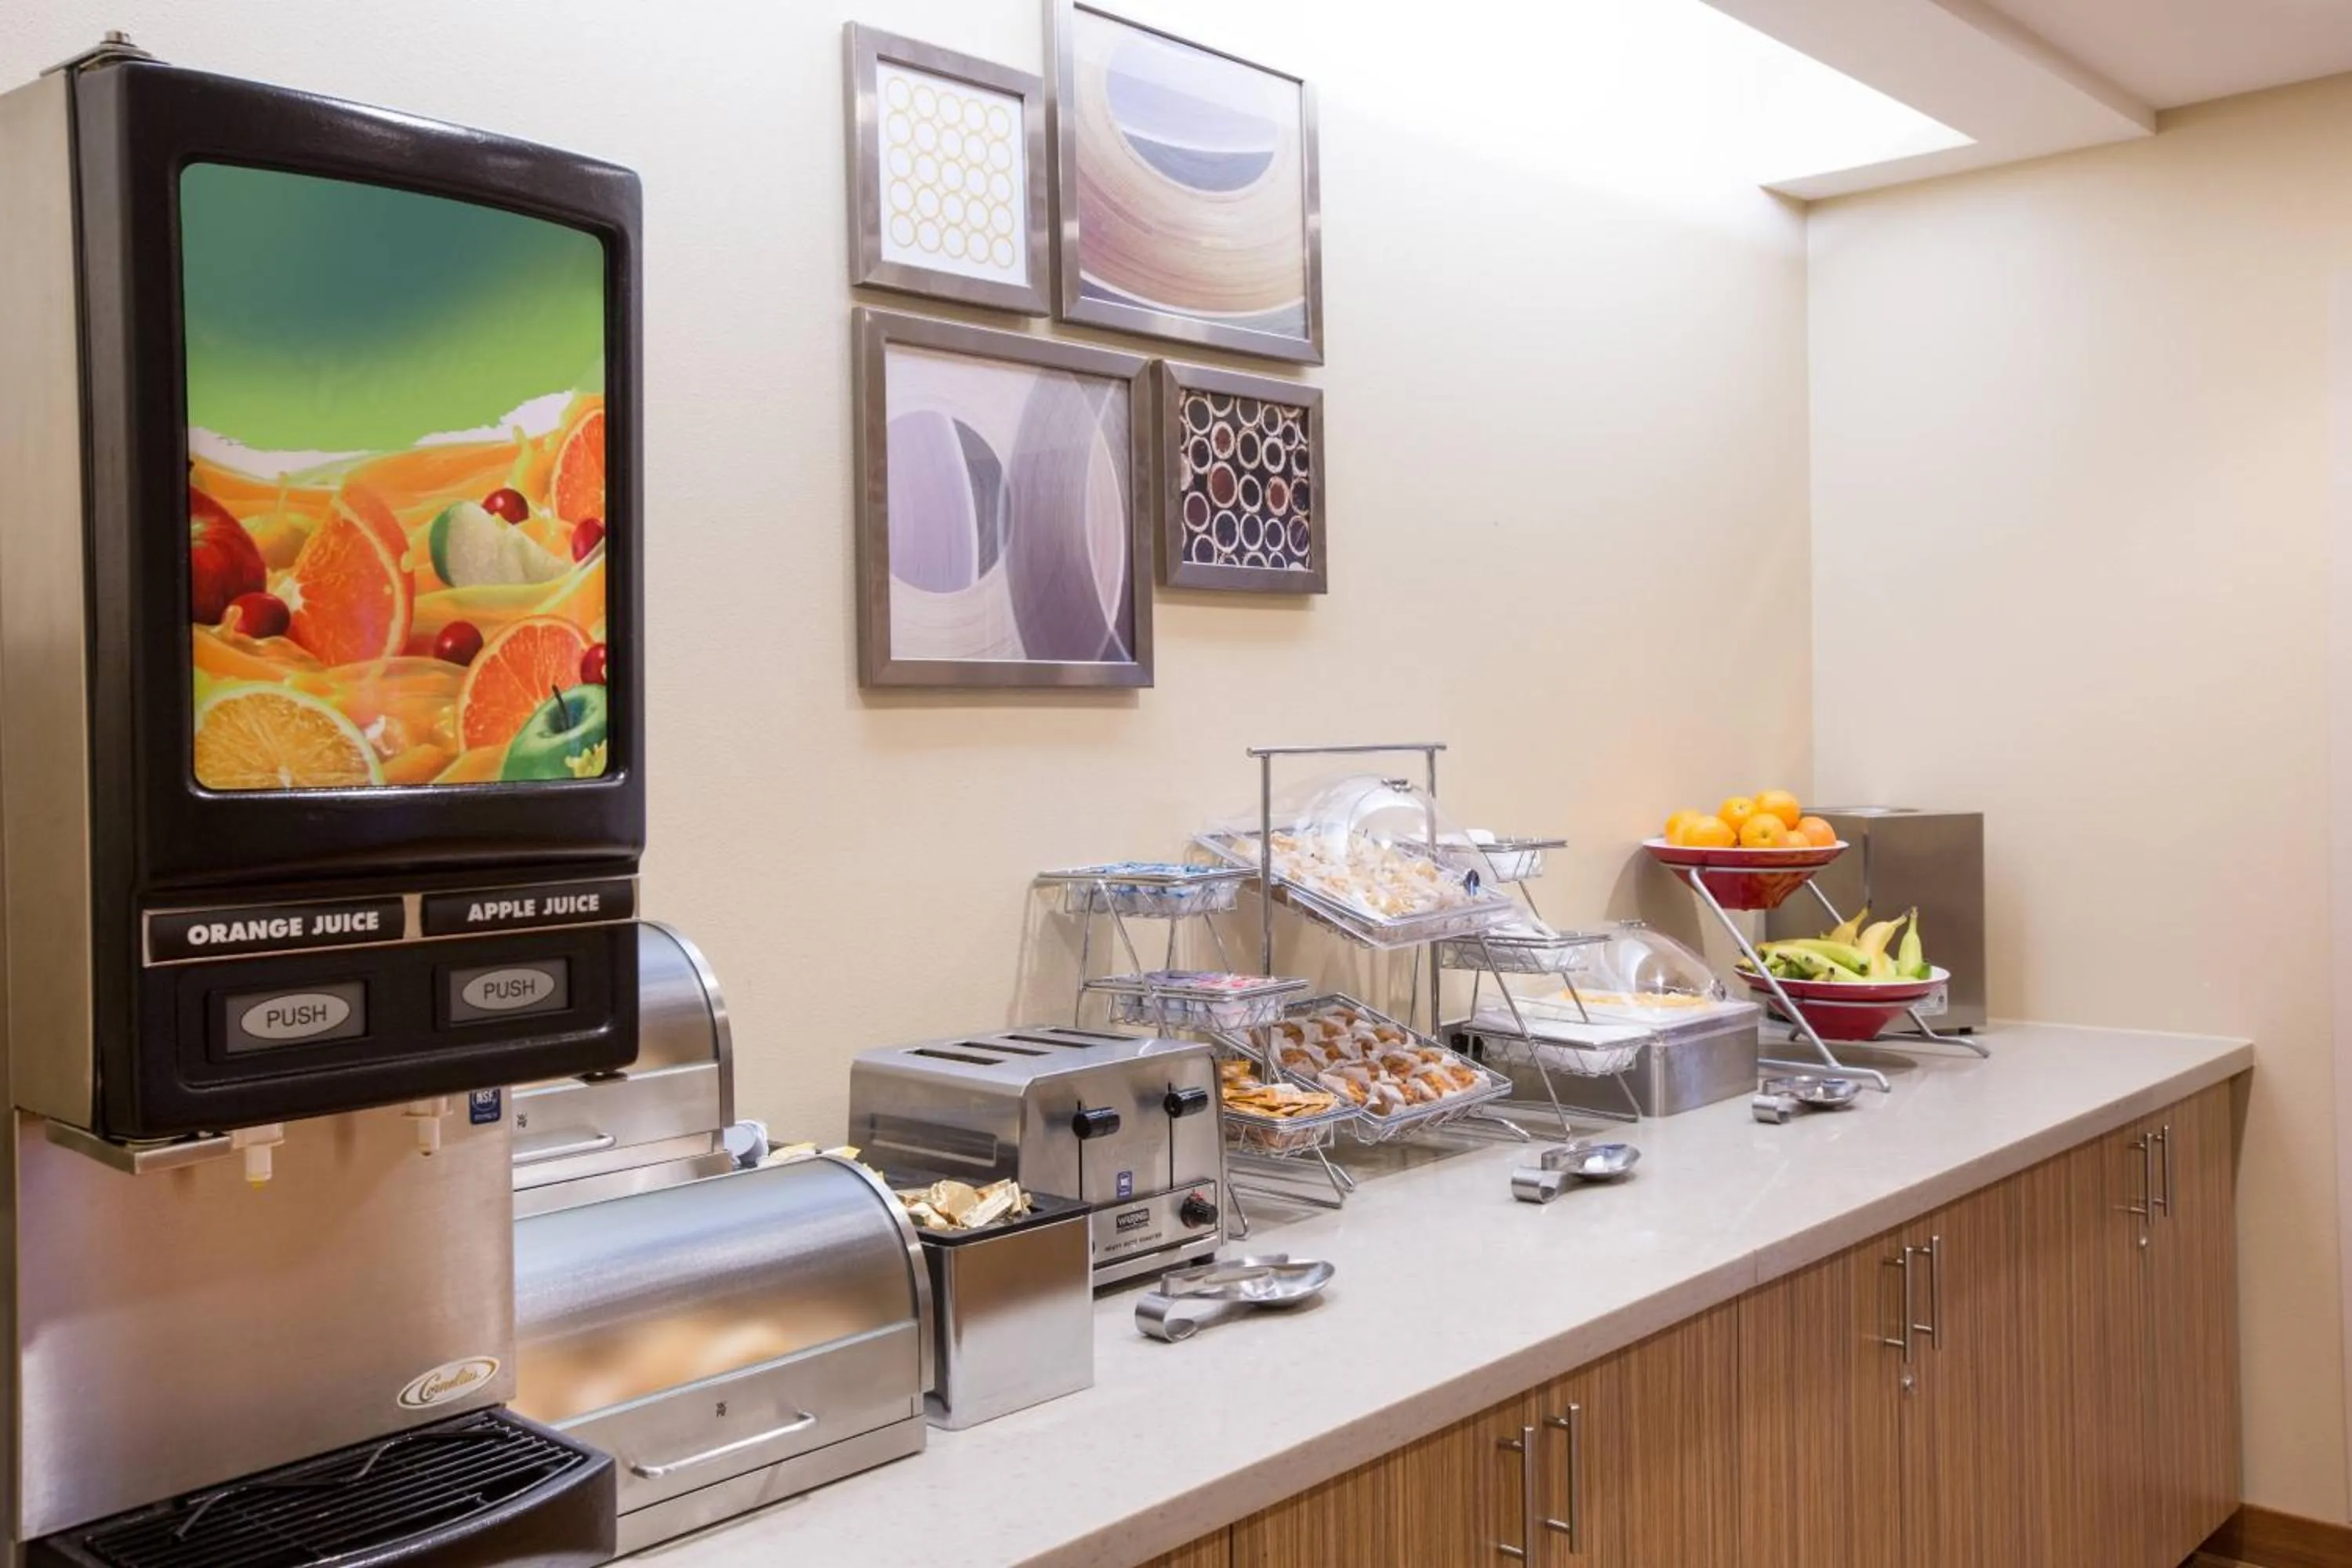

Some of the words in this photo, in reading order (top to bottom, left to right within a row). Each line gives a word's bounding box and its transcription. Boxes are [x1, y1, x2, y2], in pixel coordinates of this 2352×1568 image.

[466, 898, 536, 922] APPLE
[543, 894, 600, 916] JUICE
[187, 916, 303, 945] ORANGE
[310, 911, 379, 935] JUICE
[483, 978, 535, 1000] PUSH
[267, 1004, 327, 1029] PUSH
